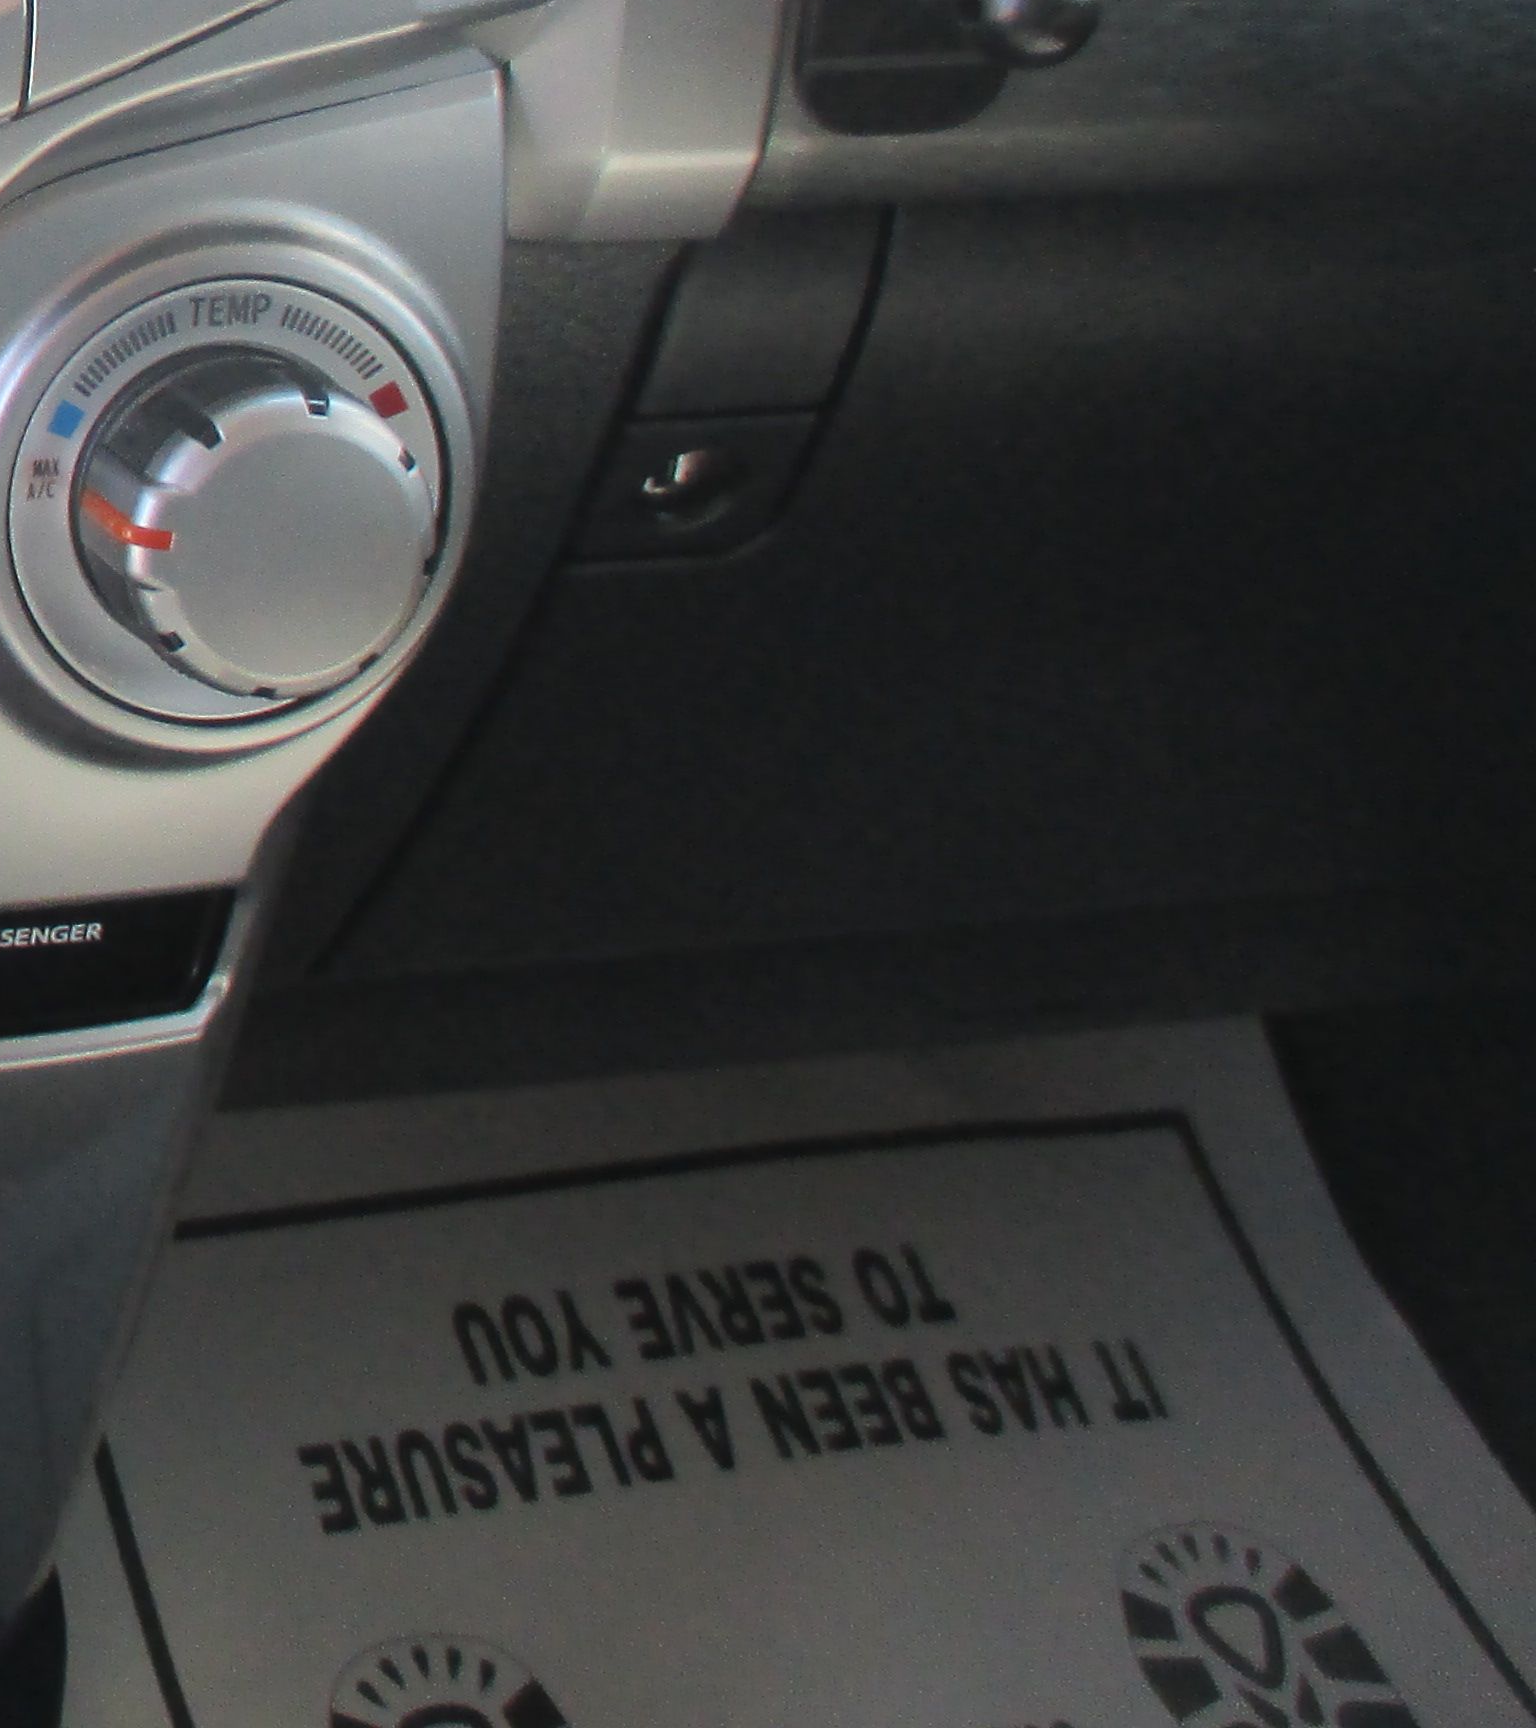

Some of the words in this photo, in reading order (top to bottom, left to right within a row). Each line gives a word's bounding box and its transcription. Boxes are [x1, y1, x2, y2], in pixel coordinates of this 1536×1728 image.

[189, 293, 272, 328] TEMP
[611, 1258, 845, 1362] SERVE
[850, 1244, 957, 1331] TO
[448, 1290, 611, 1385] YOU
[1092, 1338, 1170, 1426] IT
[678, 1384, 735, 1472] A
[749, 1357, 947, 1463] BEEN
[946, 1344, 1091, 1439] HAS
[296, 1398, 674, 1536] PLEASURE
